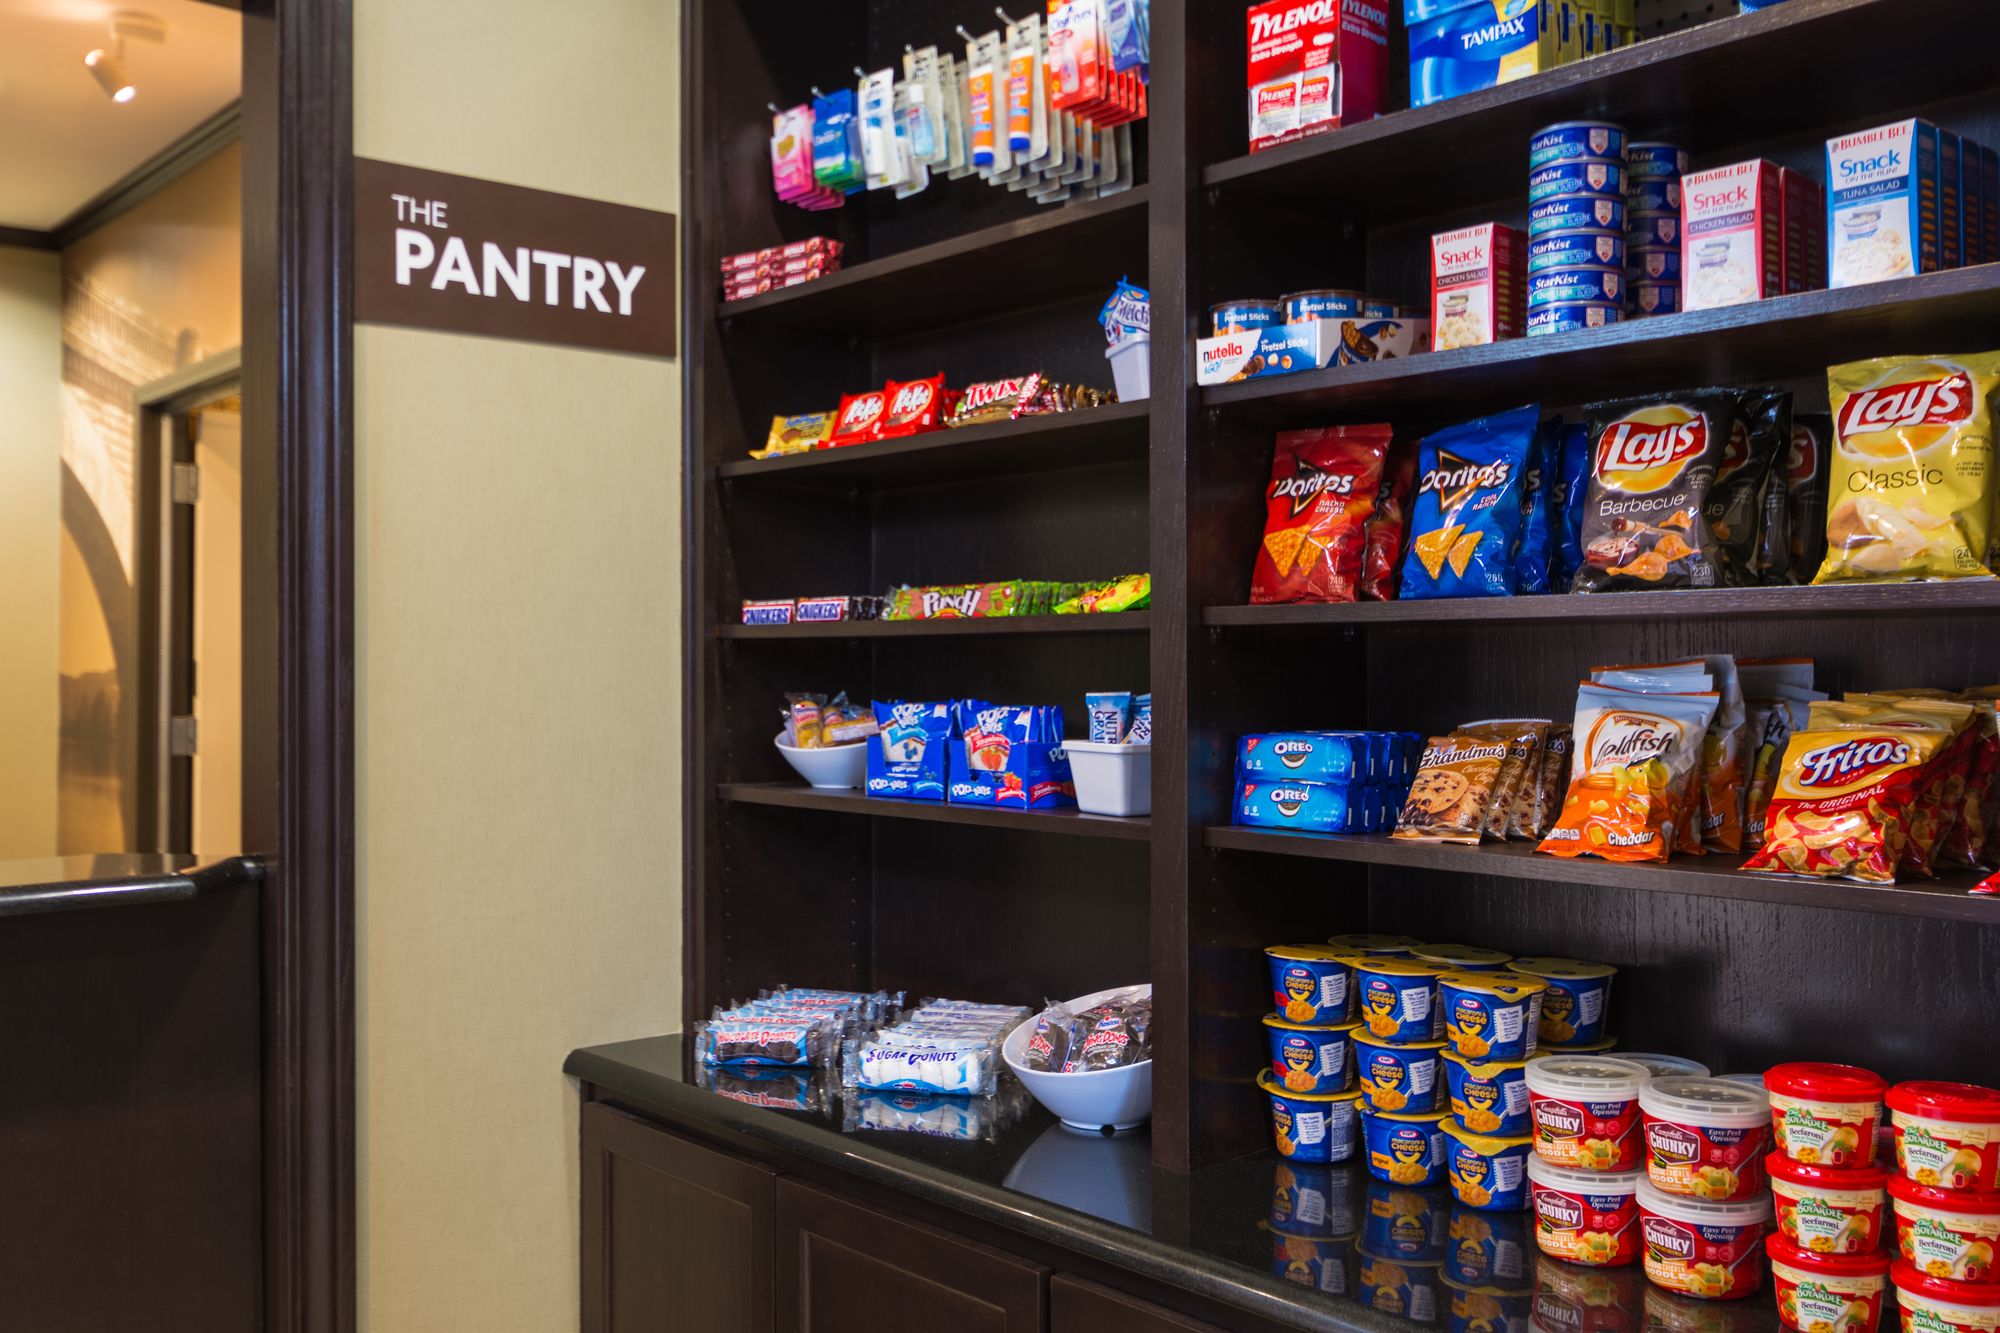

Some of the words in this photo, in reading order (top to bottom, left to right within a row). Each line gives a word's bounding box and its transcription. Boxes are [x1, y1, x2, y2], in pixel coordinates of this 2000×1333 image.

[1250, 0, 1334, 44] TYLENOL
[1342, 0, 1387, 27] TYLENOL
[1461, 16, 1525, 50] TAMPAX
[1840, 134, 1884, 151] BUMBLE
[1888, 124, 1909, 137] BEE
[1839, 150, 1901, 179] Snack
[1694, 168, 1733, 186] BUMBLE
[1693, 185, 1748, 210] Snack
[1842, 187, 1868, 199] TUNA
[1869, 180, 1901, 194] SALAD
[391, 193, 448, 229] THE
[1532, 203, 1570, 219] StarKist
[1689, 219, 1725, 233] CHICKEN
[1726, 213, 1754, 226] SALAD
[1440, 245, 1483, 267] Snack
[1532, 239, 1571, 257] StarKist
[395, 227, 646, 316] PANTRY
[1437, 273, 1465, 286] CHICKEN
[1465, 270, 1488, 281] SALAD
[1536, 273, 1579, 290] StarKist
[1300, 301, 1325, 312] Pretzel
[1326, 299, 1348, 311] Sticks
[1224, 312, 1248, 322] Pretzel
[1249, 310, 1270, 321] Sticks
[1528, 311, 1561, 328] StarKist
[1203, 342, 1243, 362] nutella
[1261, 342, 1286, 353] Pretzel
[1287, 338, 1309, 350] Sticks
[966, 378, 1023, 410] TWIX
[1842, 375, 1967, 436] Lay's
[1273, 473, 1354, 499] Doritos
[1419, 461, 1512, 495] Doritos
[1847, 464, 1944, 493] Classic
[1315, 506, 1345, 514] CHEESE
[1318, 499, 1345, 507] NACHO
[1472, 500, 1498, 511] RANCH
[1599, 494, 1688, 517] Barbecue
[1693, 566, 1711, 577] 230
[1329, 576, 1344, 586] 240
[799, 602, 841, 620] SNICKERS
[922, 589, 982, 618] PUNCH
[744, 607, 790, 625] SNICKERS
[1273, 742, 1314, 755] OREO
[1419, 743, 1506, 769] Grandma's
[1593, 728, 1673, 768] Goldfish
[1799, 740, 1911, 786] Fritos
[1270, 789, 1310, 803] OREO
[1797, 801, 1817, 810] The
[1818, 784, 1885, 809] ORIGINAL
[1607, 830, 1654, 848] Cheddar
[759, 1030, 799, 1047] DONUTS
[866, 1049, 906, 1063] SUGAR
[908, 1051, 958, 1066] DONUTS
[1536, 1108, 1580, 1132] CHUNKY
[1785, 1114, 1829, 1131] BOYARDEE
[1708, 1128, 1725, 1136] Easy
[1710, 1135, 1740, 1143] Opening
[1789, 1127, 1825, 1141] Beefaroni
[1649, 1130, 1697, 1158] CHUNKY
[1903, 1132, 1948, 1152] BOYARDEE
[1537, 1148, 1577, 1157] NOODLE
[1908, 1147, 1944, 1163] Beefaroni
[1650, 1174, 1692, 1185] NOODLE
[1536, 1198, 1579, 1225] CHUNKY
[1591, 1203, 1620, 1211] Opening
[1797, 1204, 1843, 1220] BOYARDEE
[1702, 1226, 1719, 1234] Easy
[1801, 1217, 1840, 1230] Beefaroni
[1538, 1237, 1576, 1249] NOODLE
[1644, 1225, 1690, 1255] CHUNKY
[1704, 1232, 1735, 1241] Opening
[1914, 1224, 1962, 1246] BOYARDEE
[1918, 1239, 1958, 1256] Beefaroni
[1645, 1266, 1689, 1280] NOODLE
[1796, 1287, 1842, 1305] BOYARDEE
[1800, 1301, 1839, 1316] Beefaroni
[1913, 1314, 1958, 1333] BOYARDEE
